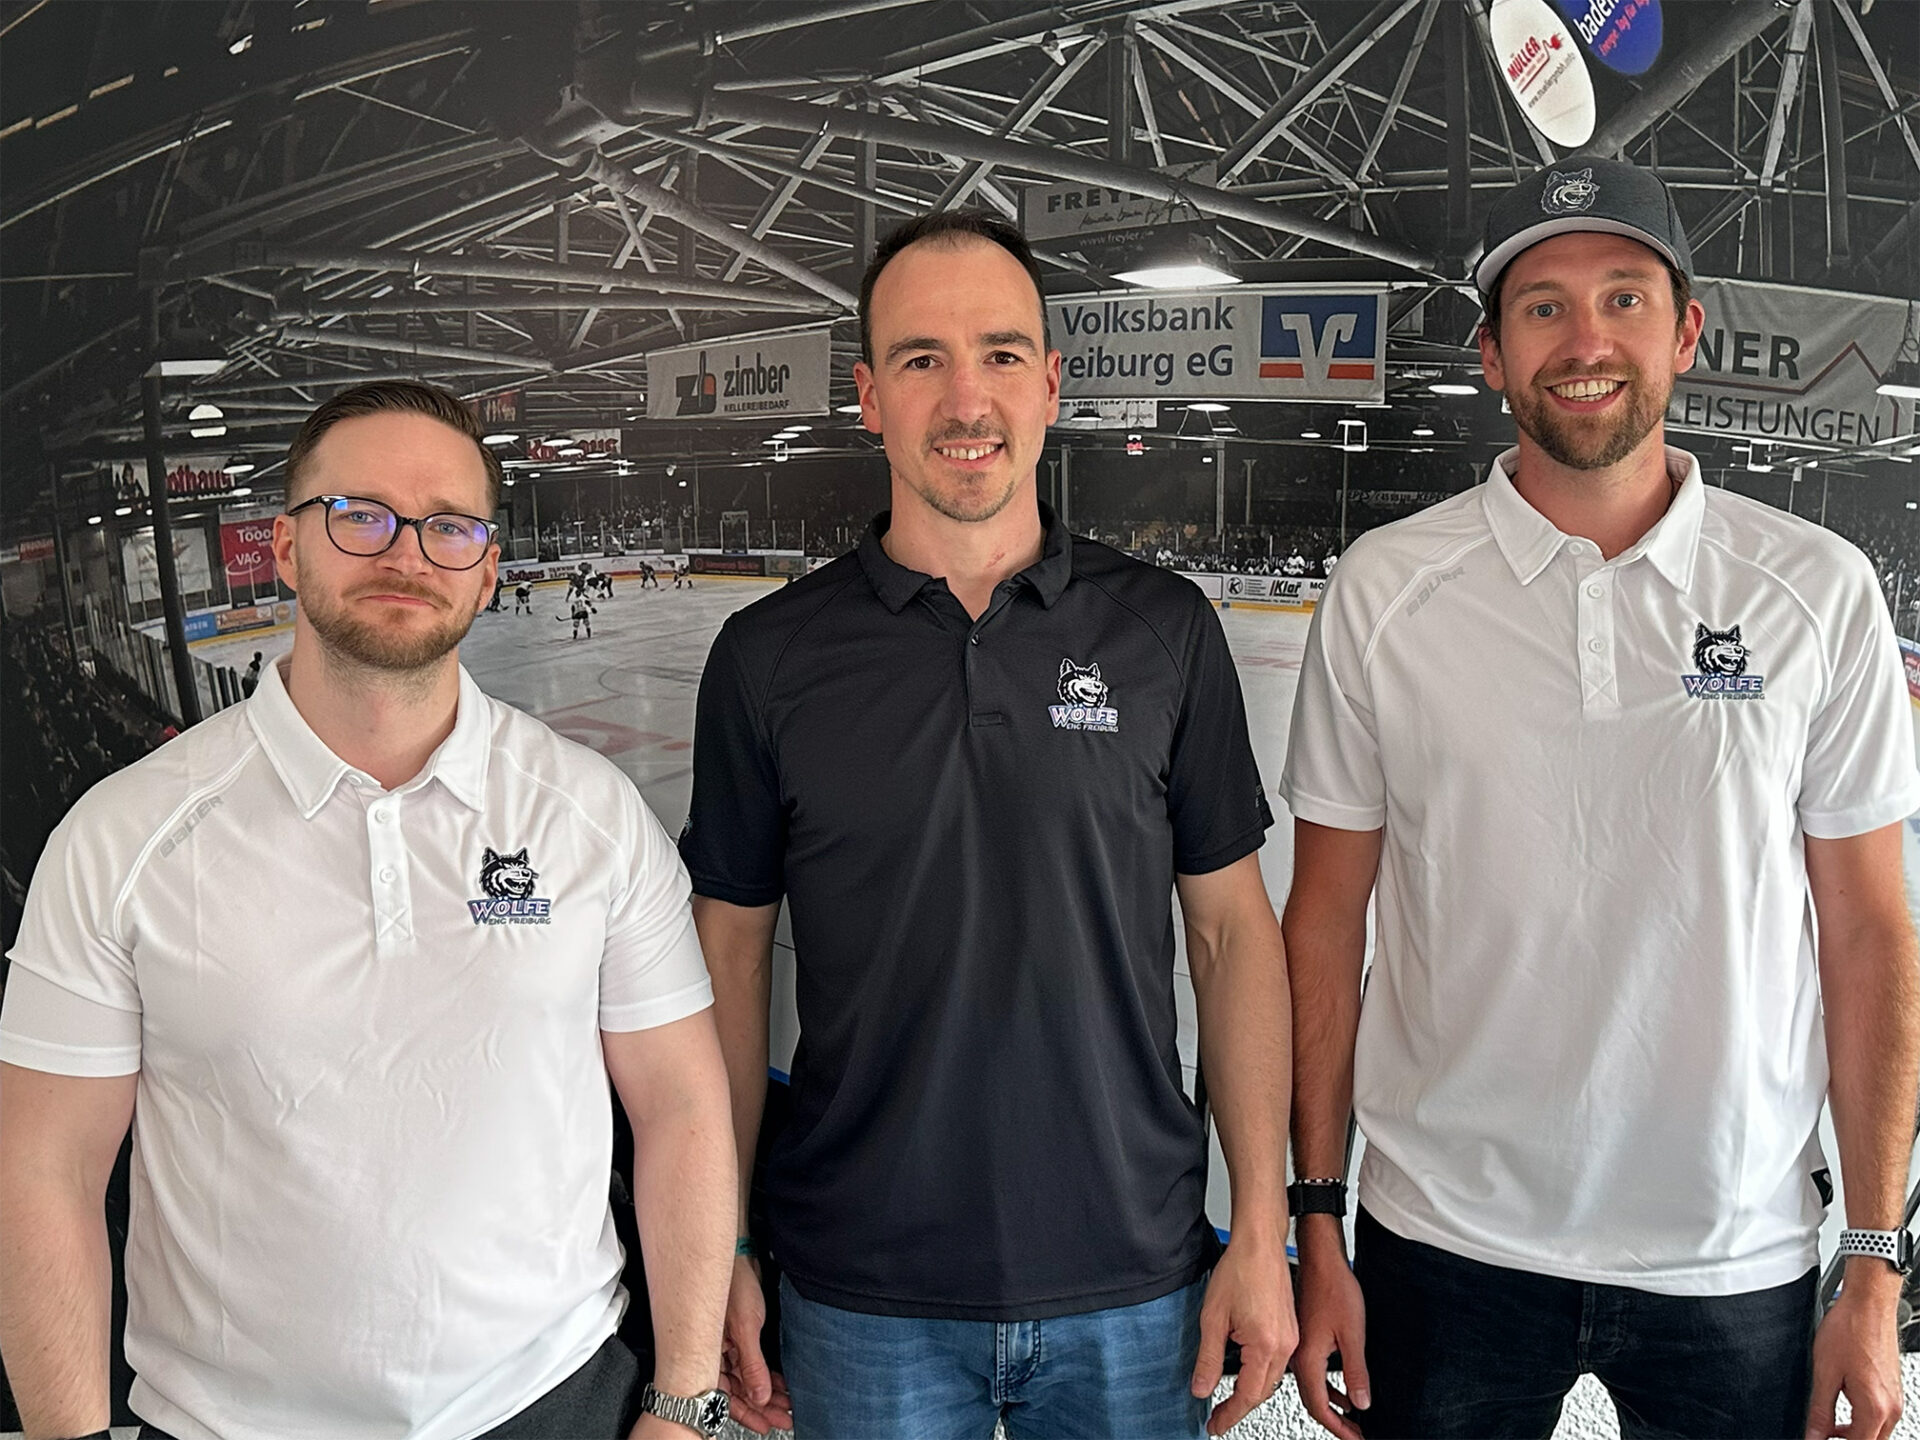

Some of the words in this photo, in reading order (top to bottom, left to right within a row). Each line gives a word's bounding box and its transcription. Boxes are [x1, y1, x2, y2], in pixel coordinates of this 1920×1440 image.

[1507, 36, 1541, 82] MÜLLER
[1061, 297, 1235, 336] Volksbank
[723, 352, 791, 398] zimber
[1061, 346, 1174, 386] reiburg
[1186, 345, 1234, 376] eG
[723, 400, 791, 413] KELLEREIBEDARF
[235, 551, 262, 566] VAG
